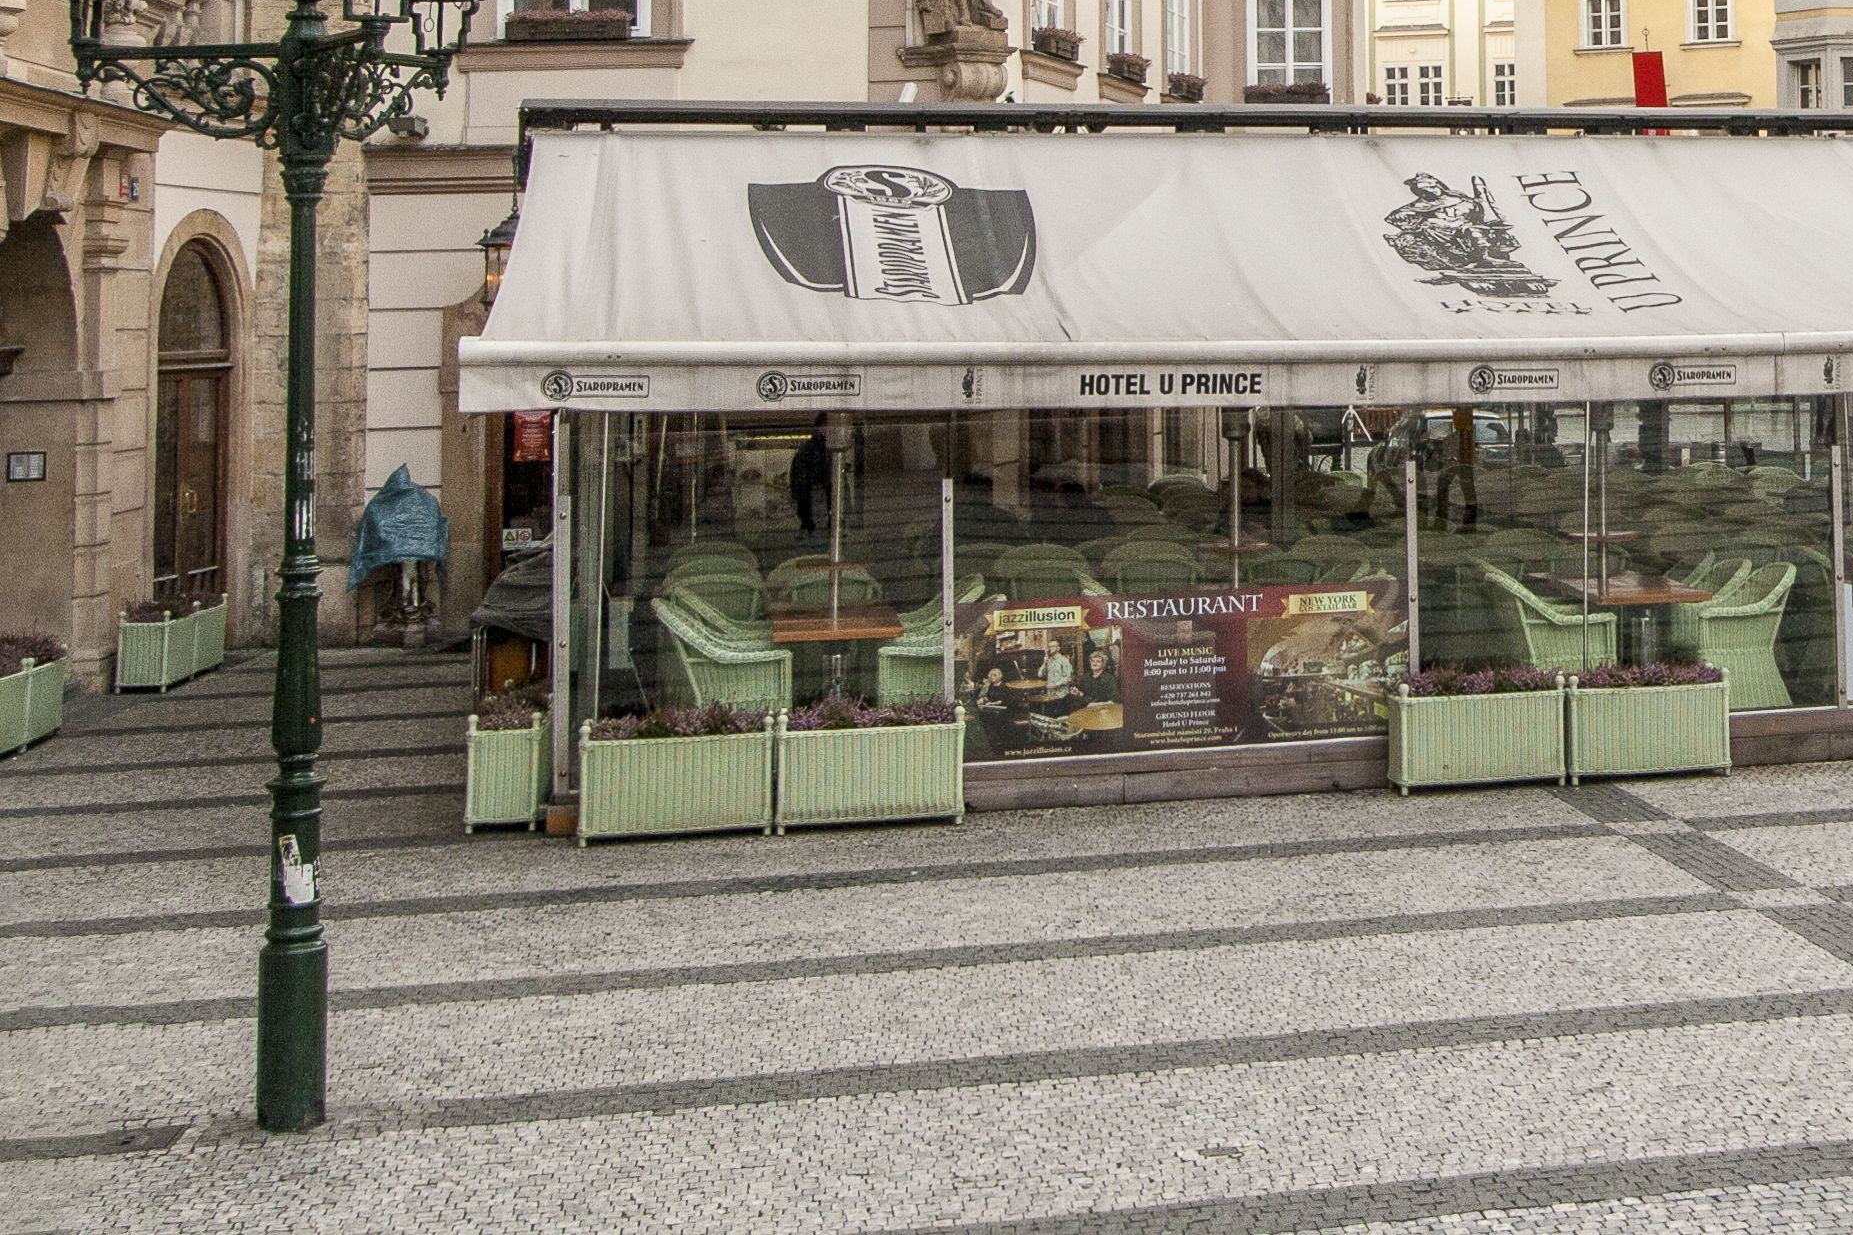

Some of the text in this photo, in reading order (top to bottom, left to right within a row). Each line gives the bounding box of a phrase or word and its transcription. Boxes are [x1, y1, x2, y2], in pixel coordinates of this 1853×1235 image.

[1511, 171, 1683, 313] U PRINCE
[872, 209, 940, 299] STAROPRAMEN
[1497, 372, 1555, 385] STAROPRAMEN
[1677, 369, 1732, 381] STAROPRAMEN
[576, 380, 644, 393] STAROPRAMEN
[790, 379, 856, 392] STAROPRAMEN
[1079, 373, 1263, 396] HOTEL U PRINCE
[1300, 594, 1357, 606] NEW YORK
[1106, 594, 1263, 620] RESTAURANT
[999, 610, 1076, 627] jazzillusion
[1158, 646, 1213, 658] LIVE MUSIC
[1144, 655, 1226, 668] Monday to Saturday
[1163, 669, 1177, 677] pm
[1179, 666, 1187, 674] to
[1189, 665, 1211, 674] 11:00
[1213, 666, 1227, 675] pm
[1156, 710, 1216, 720] GROUND FLOOR
